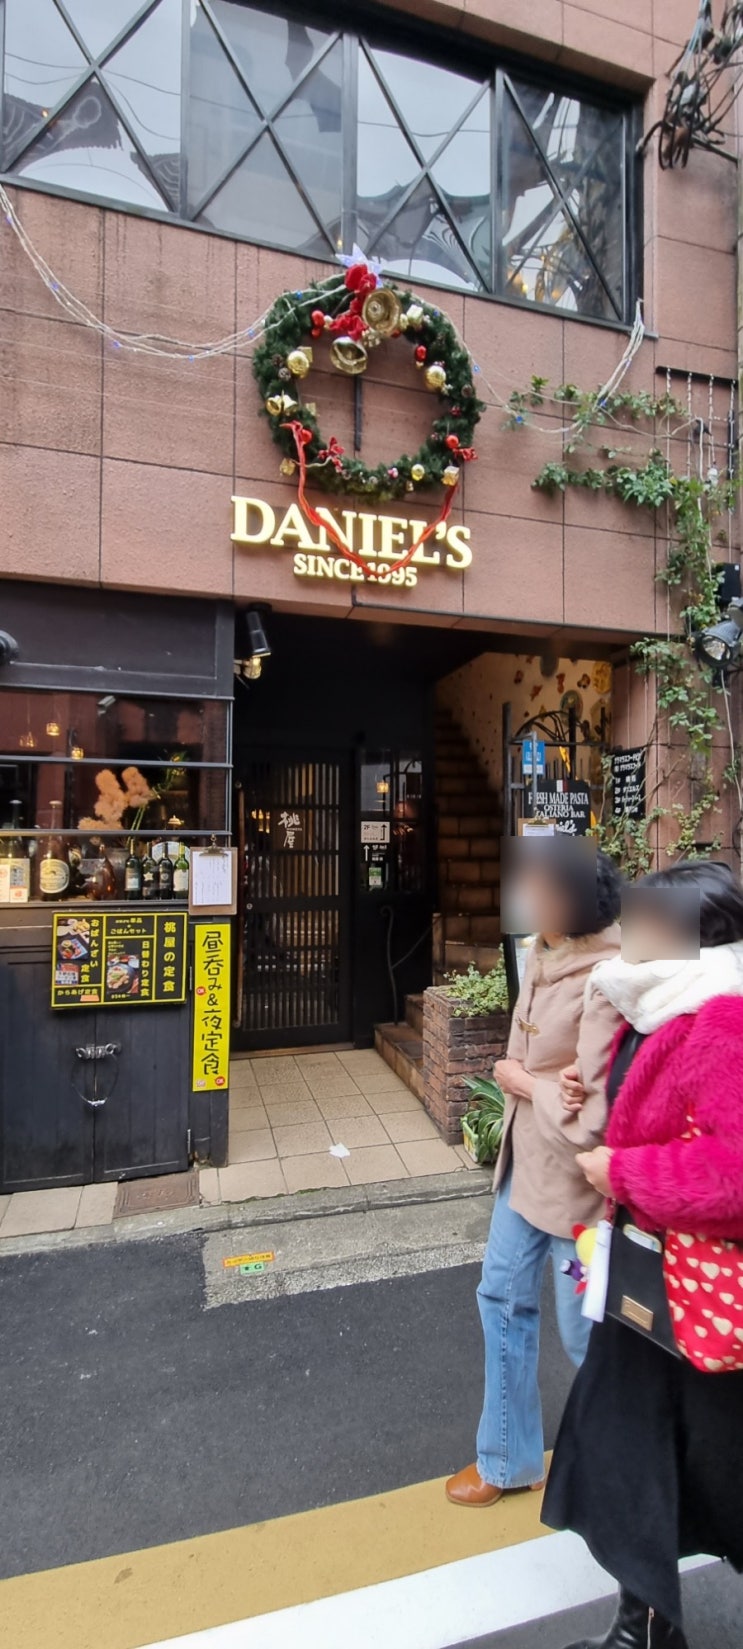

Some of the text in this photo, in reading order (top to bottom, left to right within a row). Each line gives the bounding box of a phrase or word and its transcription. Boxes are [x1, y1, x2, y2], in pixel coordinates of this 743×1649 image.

[230, 495, 473, 569] DANIEL'S
[293, 553, 418, 587] SINCE 1995
[528, 792, 589, 805] FESH MADE PASTA
[543, 804, 574, 812] OSTERIA
[278, 811, 301, 848] 桃屋
[80, 963, 90, 984] 定食
[140, 940, 150, 997] 日替わり定食
[163, 921, 177, 992] 桃屋の定食
